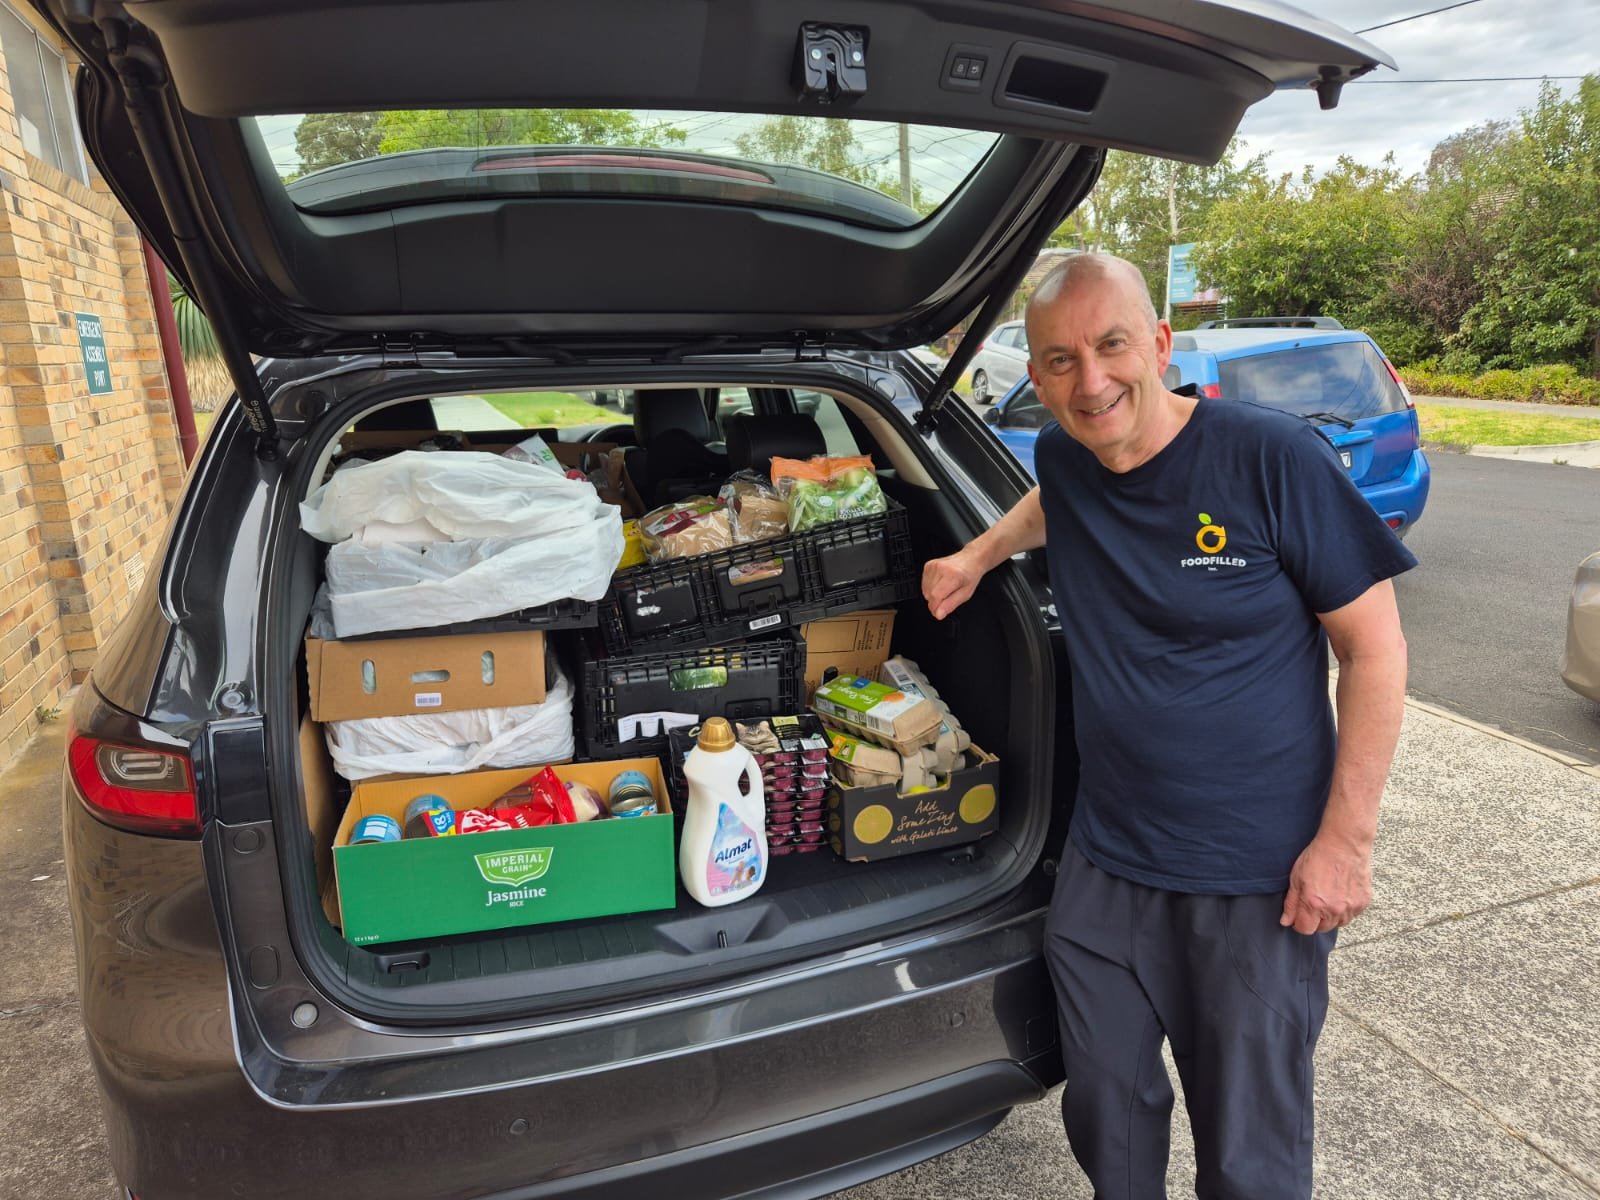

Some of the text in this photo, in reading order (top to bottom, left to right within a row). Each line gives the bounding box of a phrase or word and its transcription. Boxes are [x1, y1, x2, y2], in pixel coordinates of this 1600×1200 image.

[1180, 556, 1247, 568] FOODFILLED
[914, 799, 938, 815] Add
[896, 809, 956, 832] Some Zing
[714, 837, 753, 864] Almat
[485, 853, 545, 869] IMPERIAL
[485, 886, 547, 907] Jasmine
